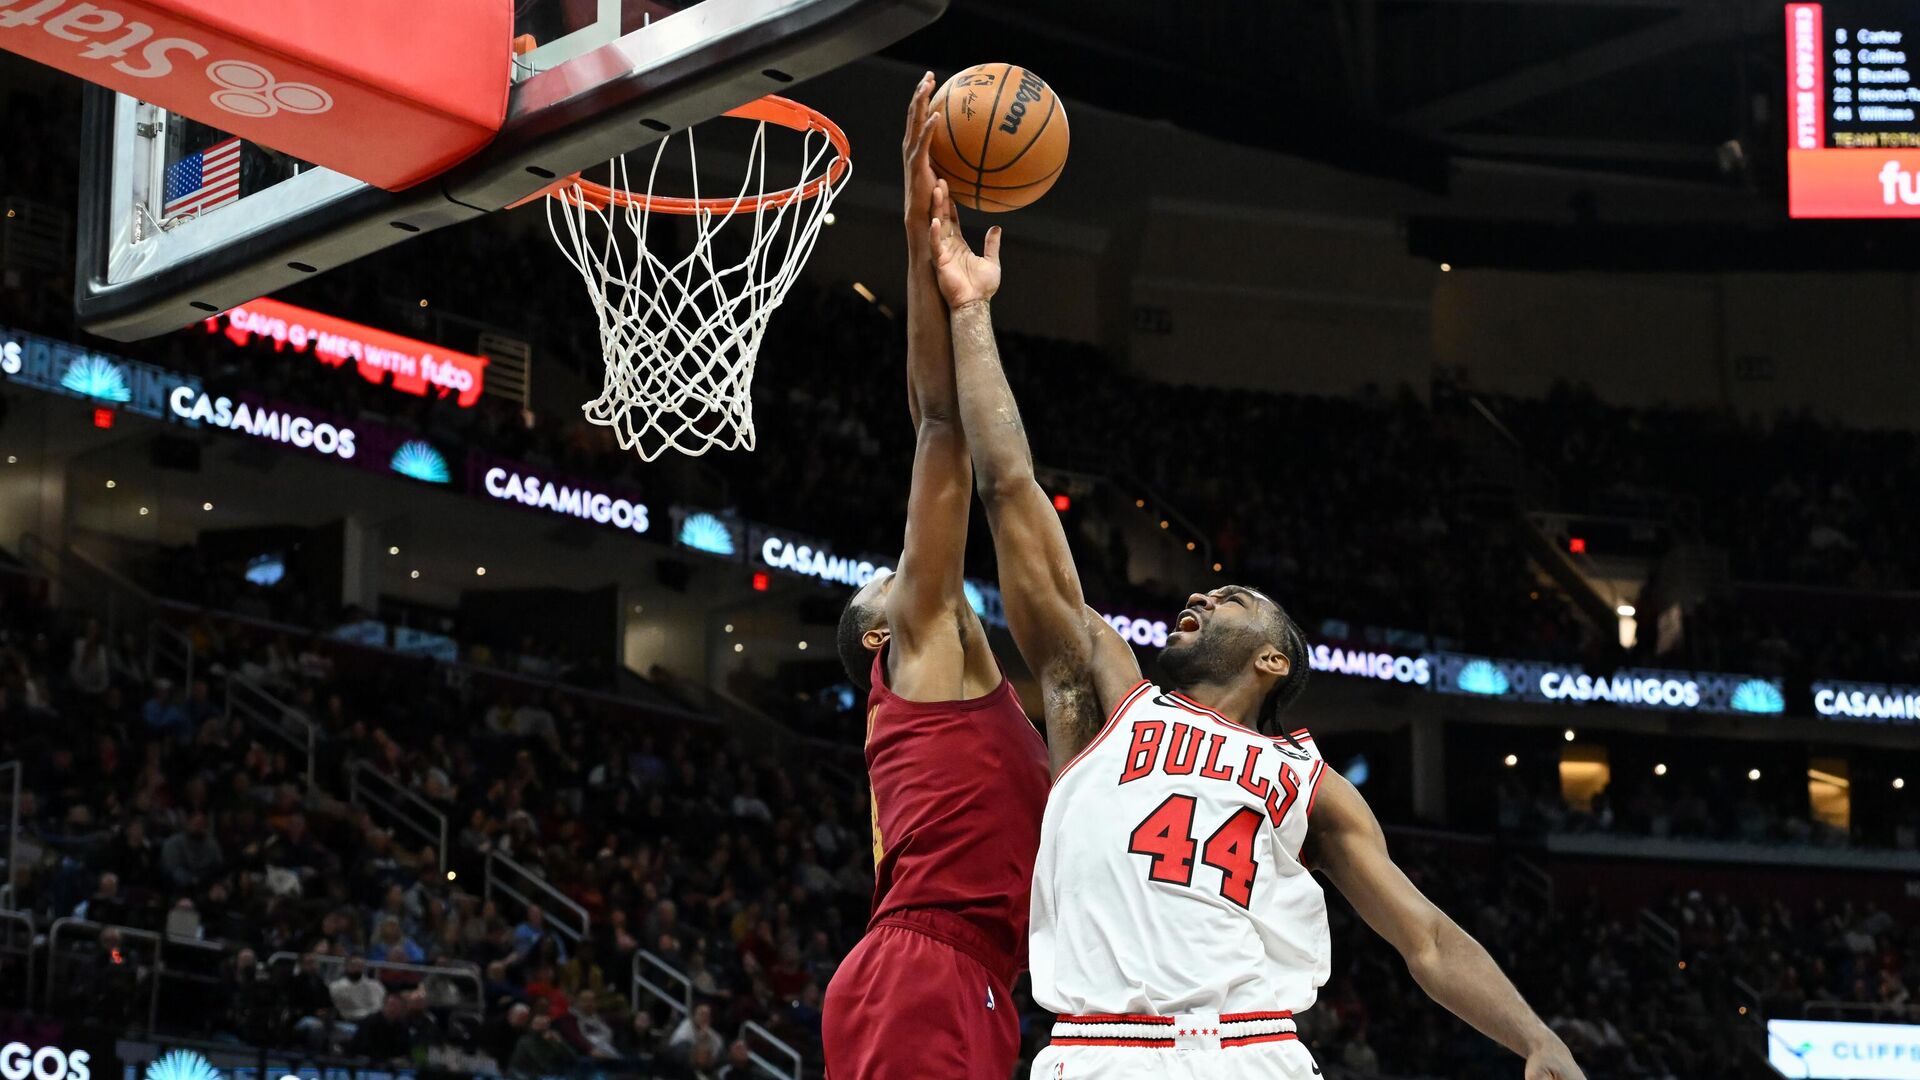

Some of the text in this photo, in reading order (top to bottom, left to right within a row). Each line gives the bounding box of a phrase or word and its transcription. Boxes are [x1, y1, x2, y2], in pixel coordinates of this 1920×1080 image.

[0, 0, 208, 77] Stat
[229, 307, 287, 341] CAVS
[363, 343, 416, 376] WITH
[170, 386, 356, 459] CASAMIGOS
[485, 467, 649, 533] CASAMIGOS
[1103, 614, 1168, 648] GOS
[1540, 672, 1699, 707] CASAMIGOS
[1118, 720, 1301, 828] BULLS
[1128, 793, 1266, 911] 44
